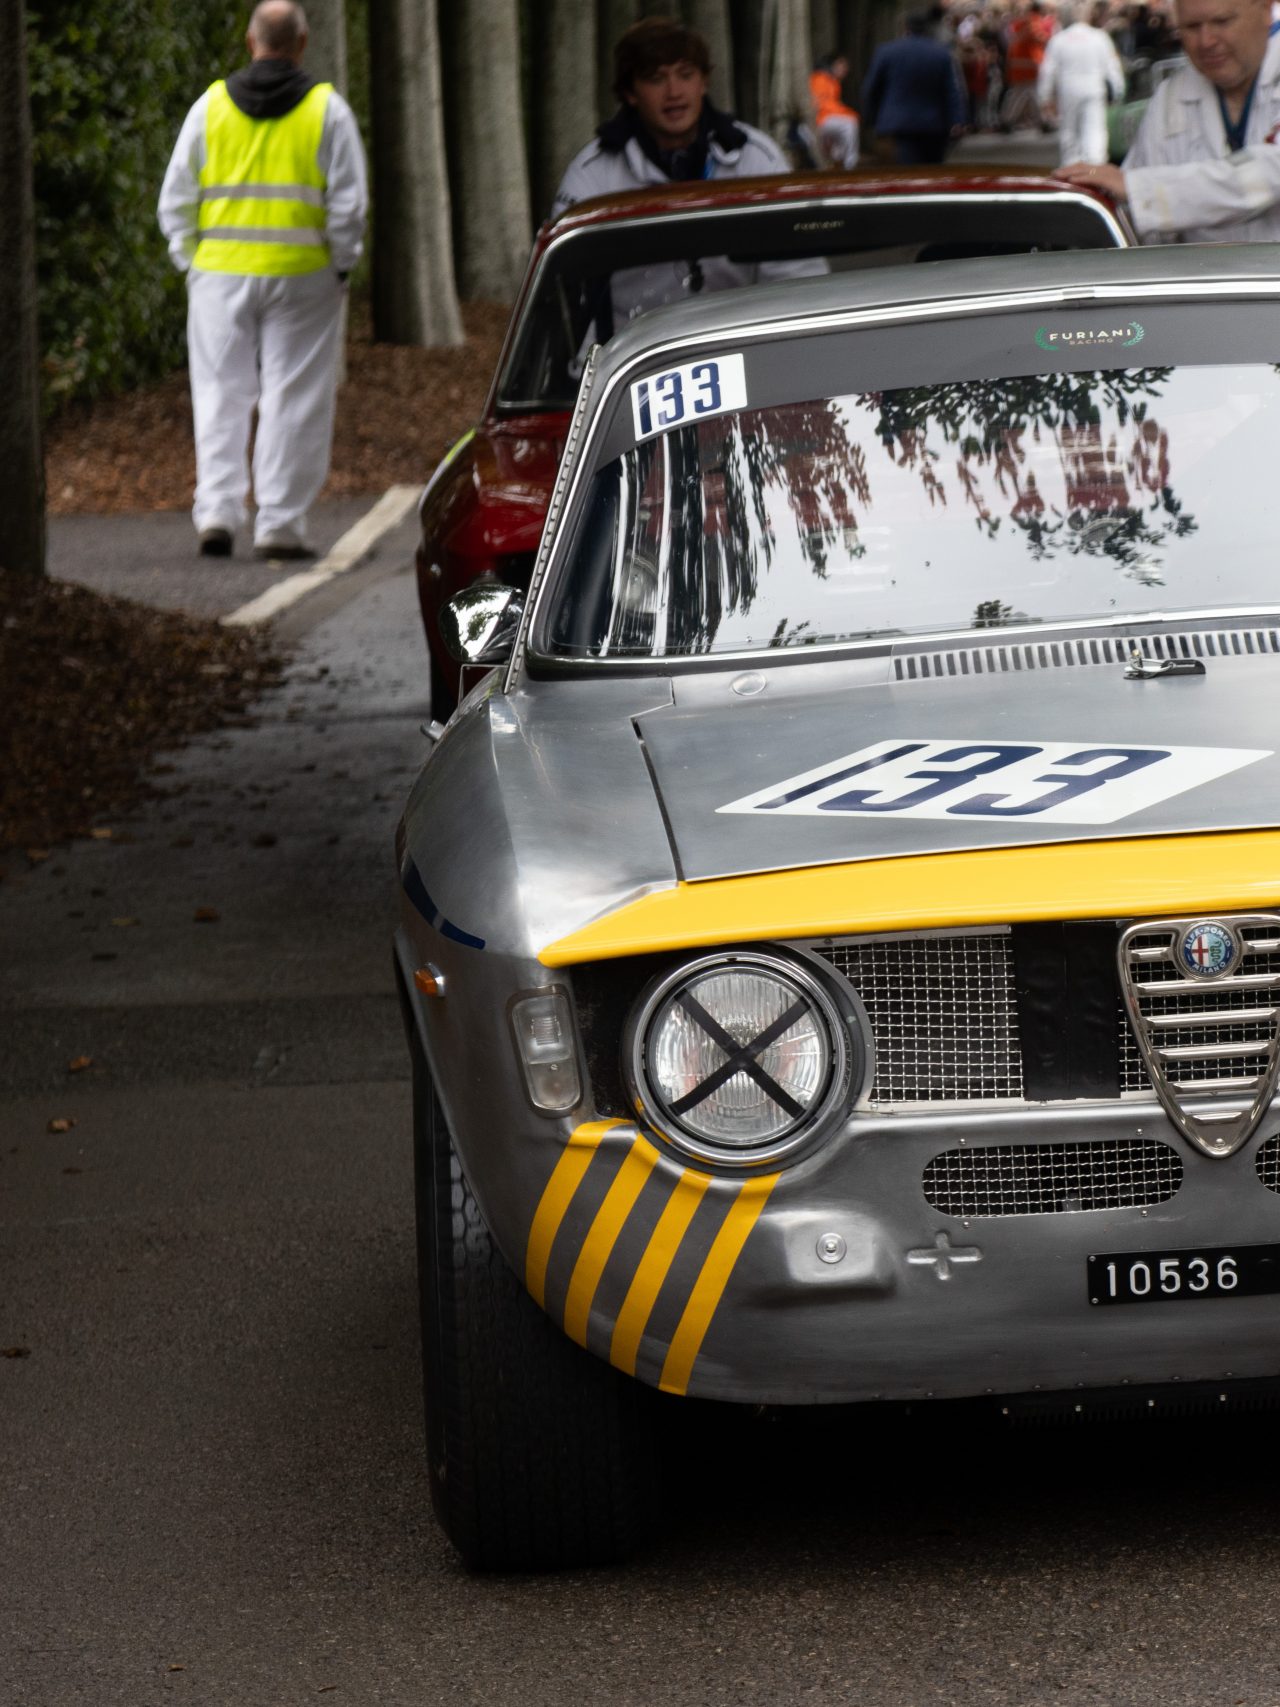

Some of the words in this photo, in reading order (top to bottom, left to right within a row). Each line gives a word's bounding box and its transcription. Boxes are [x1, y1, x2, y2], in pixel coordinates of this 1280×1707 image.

[1049, 328, 1132, 341] FURIANI
[1069, 338, 1114, 346] RACING
[637, 362, 722, 435] 133
[753, 744, 1172, 816] 133
[1192, 961, 1226, 974] MILANO
[1107, 1257, 1238, 1298] 10536
